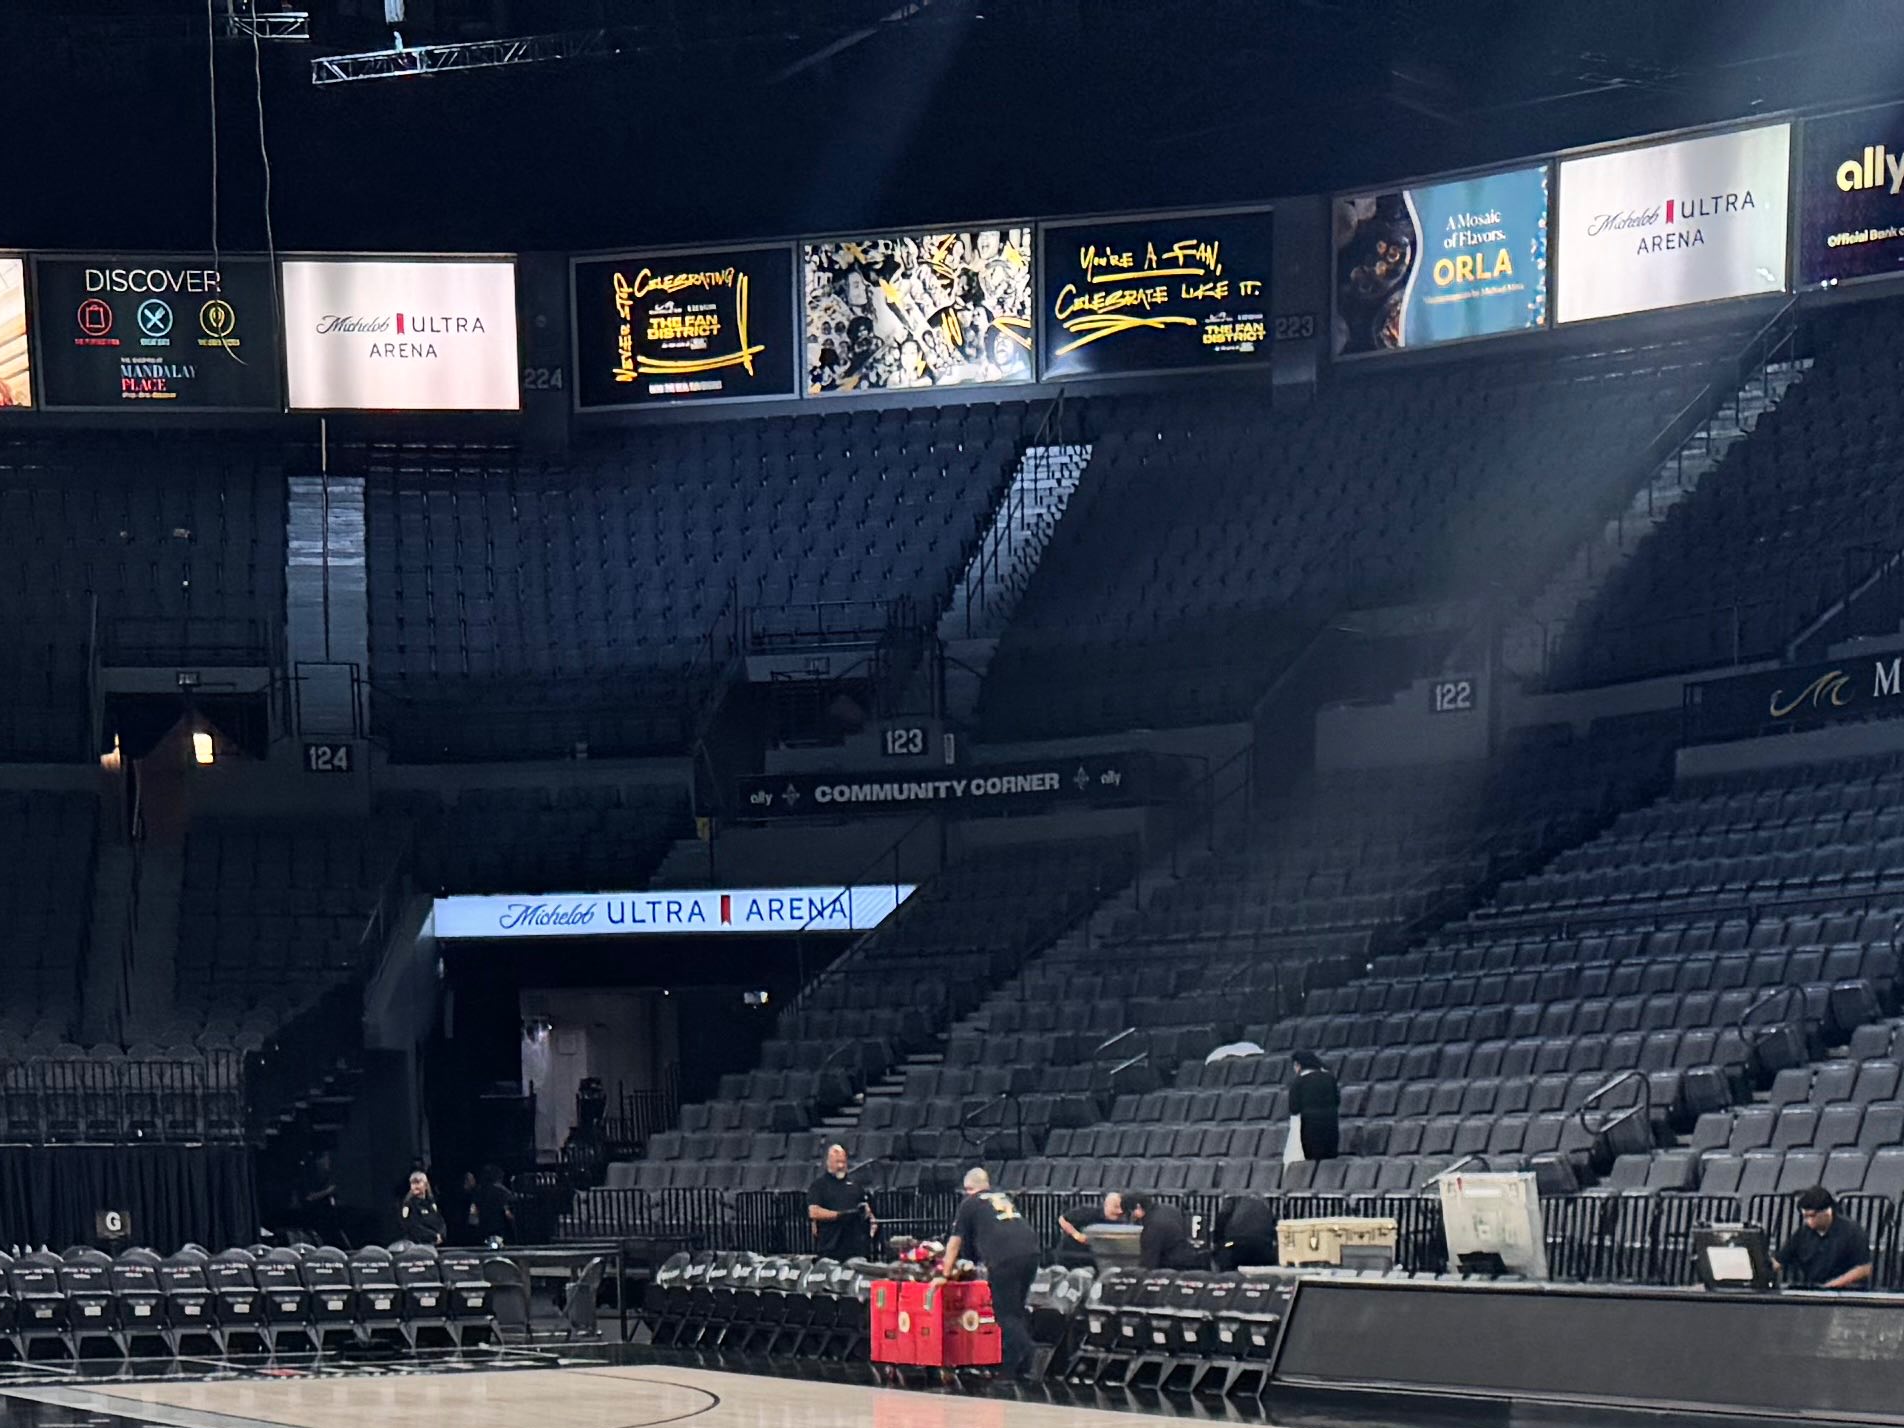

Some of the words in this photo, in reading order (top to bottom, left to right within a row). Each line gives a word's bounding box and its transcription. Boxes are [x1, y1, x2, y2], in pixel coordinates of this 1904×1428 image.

[1446, 215, 1455, 230] A
[1457, 208, 1501, 229] Mosaic
[1587, 207, 1659, 236] Michelob
[1681, 192, 1755, 219] ULTRA
[1444, 231, 1458, 249] of
[1637, 229, 1705, 256] ARENA
[1827, 229, 1868, 247] Official
[1870, 228, 1897, 241] Bank
[1145, 242, 1157, 269] A
[1433, 248, 1513, 286] ORLA
[85, 269, 222, 293] DISCOVER
[1182, 281, 1229, 299] LIKE
[1239, 281, 1261, 296] IT.
[316, 315, 390, 335] Michelob
[412, 316, 485, 334] ULTRA
[647, 324, 721, 340] DISTRICT
[650, 317, 682, 329] THE
[685, 314, 718, 326] FAN
[1205, 324, 1232, 335] THE
[1235, 322, 1265, 334] FAN
[1202, 331, 1267, 344] DISTRICT
[369, 343, 438, 358] ARENA
[121, 364, 195, 379] MANDALAY
[523, 368, 564, 389] 224
[121, 378, 166, 391] PLACE
[1434, 684, 1472, 712] 122
[886, 729, 923, 754] 123
[309, 746, 347, 770] 124
[751, 790, 773, 806] ally
[815, 780, 967, 803] COMMUNITY
[971, 773, 1059, 795] CORNER
[1101, 770, 1121, 786] ally
[500, 903, 597, 929] Michelob
[607, 900, 706, 924] ULTRA
[746, 897, 848, 922] ARENA
[105, 1212, 121, 1231] G
[1191, 1215, 1204, 1239] F
